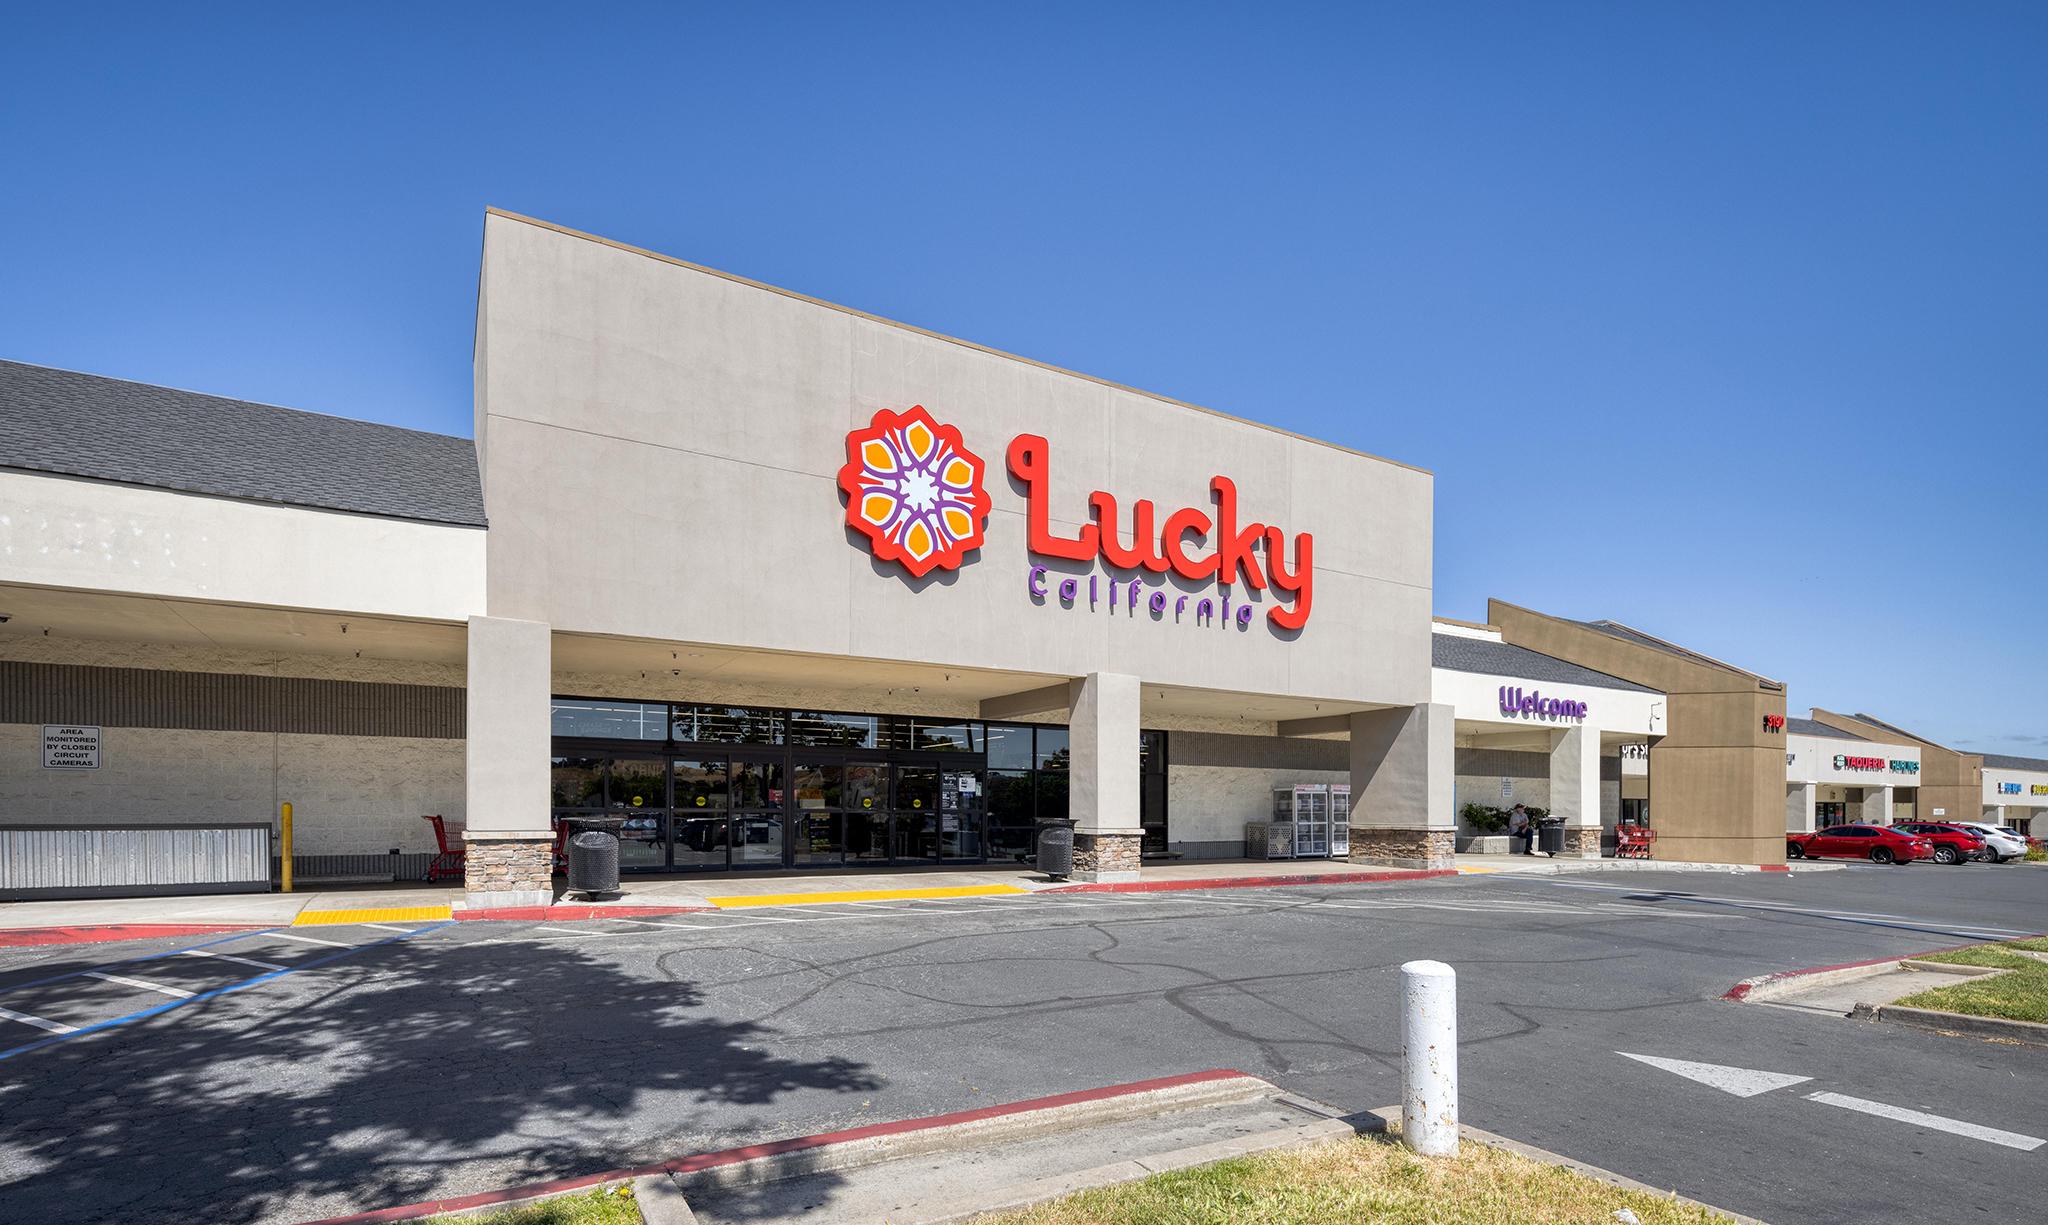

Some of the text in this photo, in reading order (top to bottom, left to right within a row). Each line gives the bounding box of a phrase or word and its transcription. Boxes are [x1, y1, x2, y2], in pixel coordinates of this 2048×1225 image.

[1006, 434, 1313, 629] Lucky
[1028, 564, 1253, 624] California
[1498, 685, 1588, 718] Welcome
[1845, 755, 1886, 769] TAQUERIA
